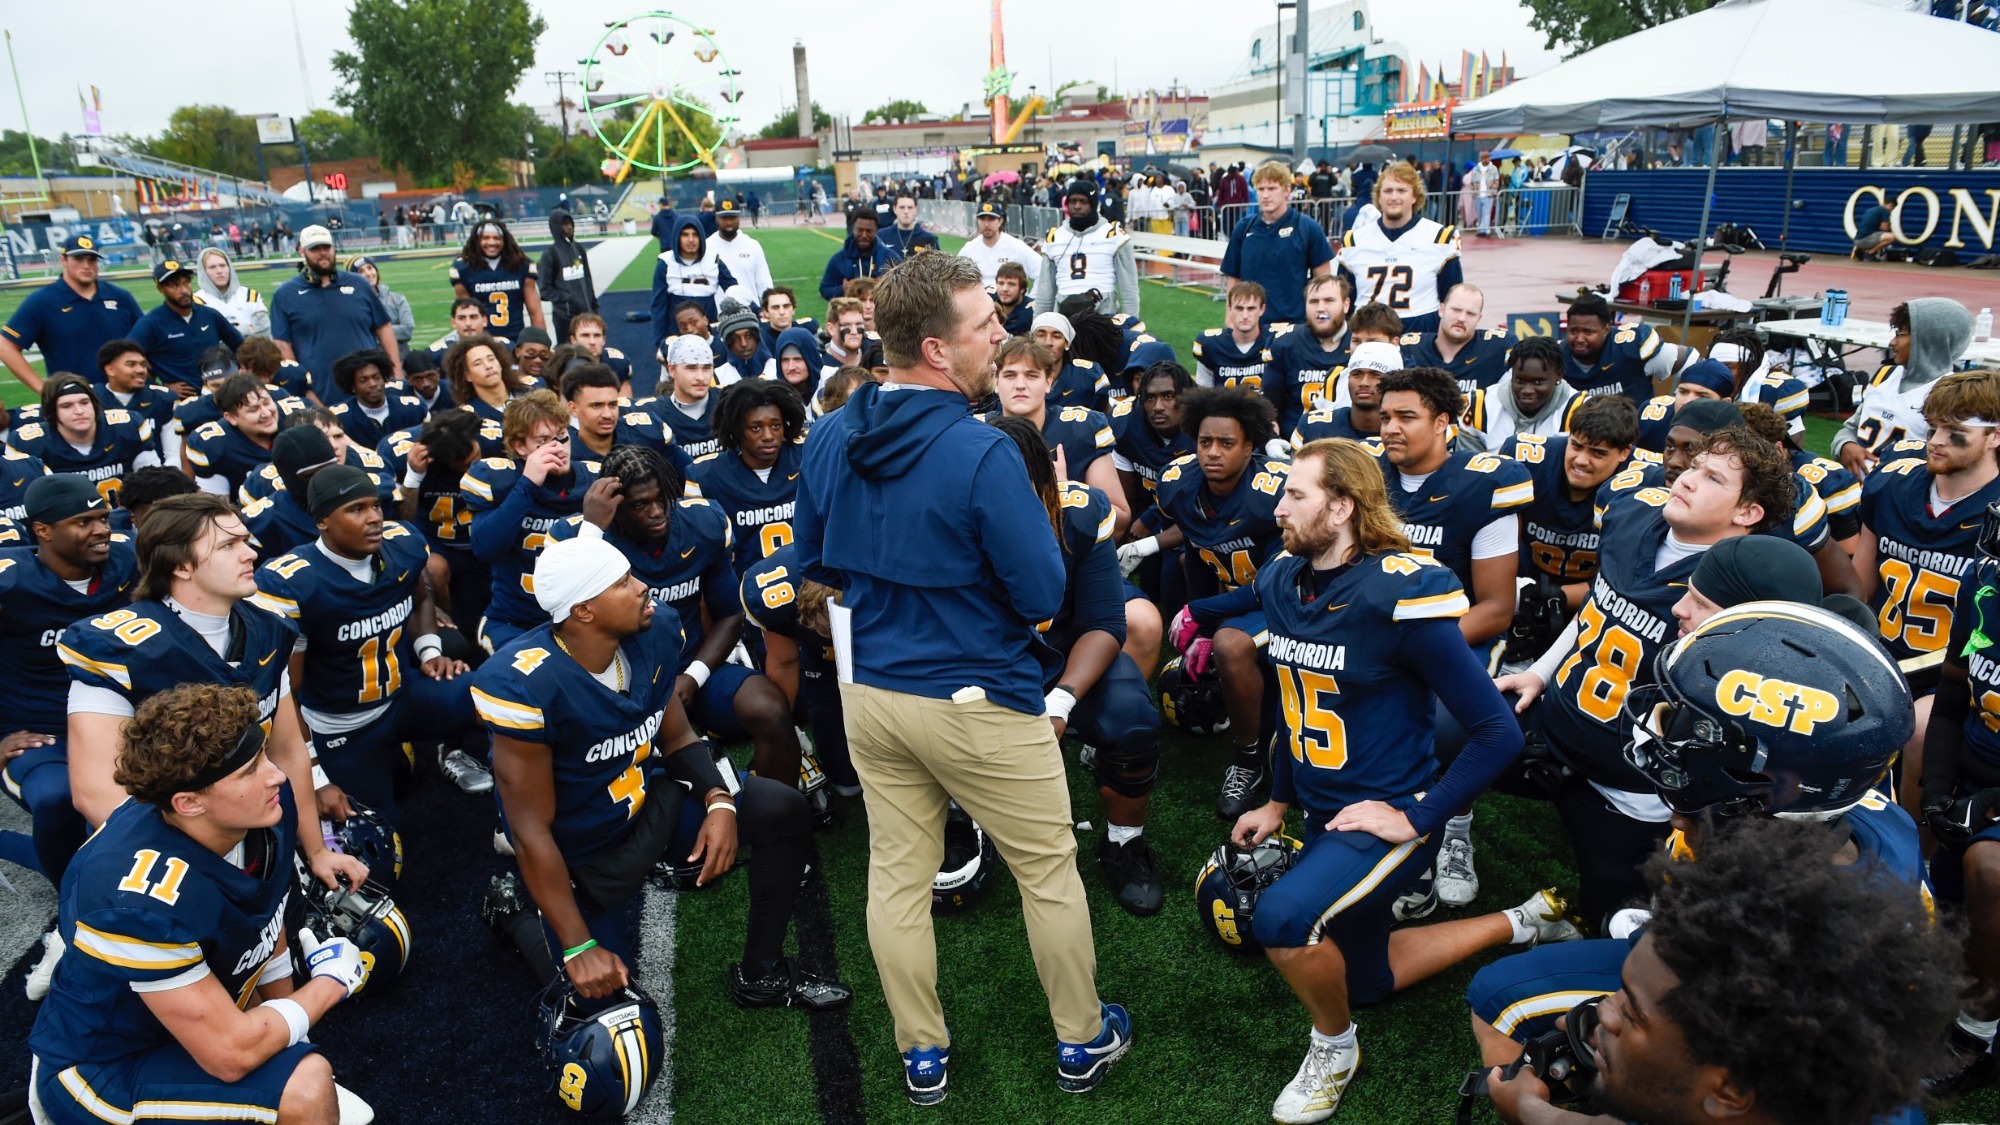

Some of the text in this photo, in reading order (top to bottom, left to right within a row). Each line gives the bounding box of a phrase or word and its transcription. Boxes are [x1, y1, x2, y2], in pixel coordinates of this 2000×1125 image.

[324, 173, 348, 190] 40
[475, 279, 520, 293] CONCORDIA
[1367, 265, 1413, 310] 72
[489, 291, 509, 327] 3
[1219, 364, 1266, 377] CONCORDI
[1798, 457, 1844, 485] 83
[736, 501, 795, 526] CONCOR
[1527, 521, 1600, 550] CONCORD
[265, 553, 311, 580] 11
[648, 575, 700, 603] CORDIA
[755, 565, 796, 610] 18
[337, 595, 413, 642] CONCORDIA
[1593, 571, 1668, 644] CONCORDIA
[1879, 557, 1961, 652] 85
[91, 609, 162, 646] 90
[358, 626, 403, 703] 11
[511, 647, 551, 676] 4
[1268, 632, 1346, 671] CONCORDIA
[1556, 596, 1644, 723] 78
[1276, 664, 1348, 770] 45
[1715, 669, 1840, 736] CSP
[326, 736, 347, 749] CSP
[585, 705, 667, 763] CONCORD
[607, 740, 651, 821] 4
[118, 848, 190, 907] 11
[1212, 898, 1242, 945] CSP
[558, 1062, 588, 1112] CSP
